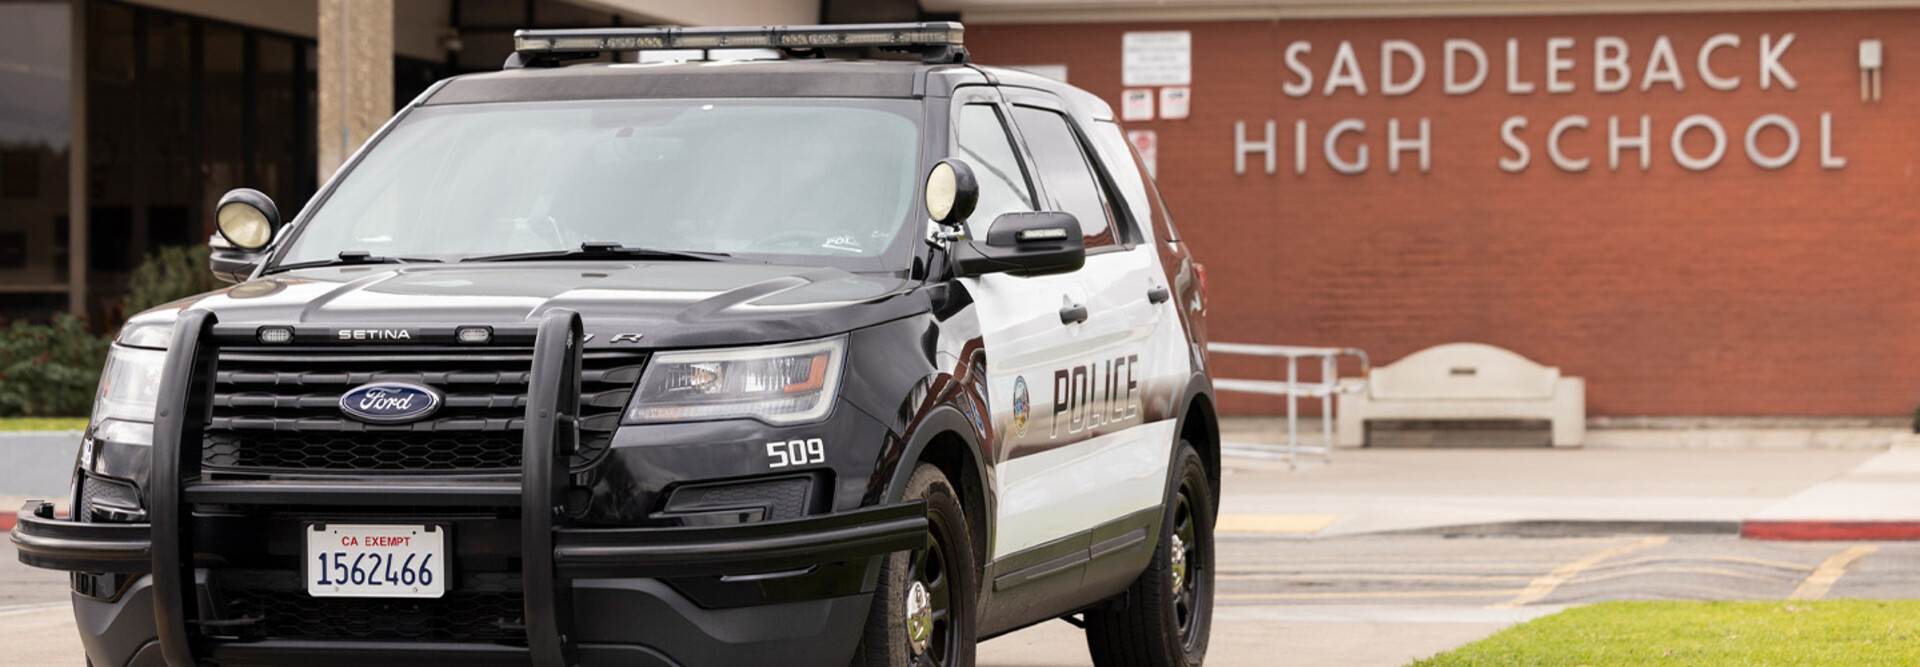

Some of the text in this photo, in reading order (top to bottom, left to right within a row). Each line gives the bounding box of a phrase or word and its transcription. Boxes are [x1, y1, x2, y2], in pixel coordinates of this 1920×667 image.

[1282, 33, 1797, 96] SADDLEBACK
[1234, 112, 1846, 175] HIGH SCHOOL
[338, 329, 411, 339] SETINA
[360, 387, 414, 410] Ford
[1050, 354, 1138, 439] POLICE
[766, 438, 825, 468] 509
[341, 536, 411, 546] CA EXEMPT
[317, 552, 433, 586] 1562466
